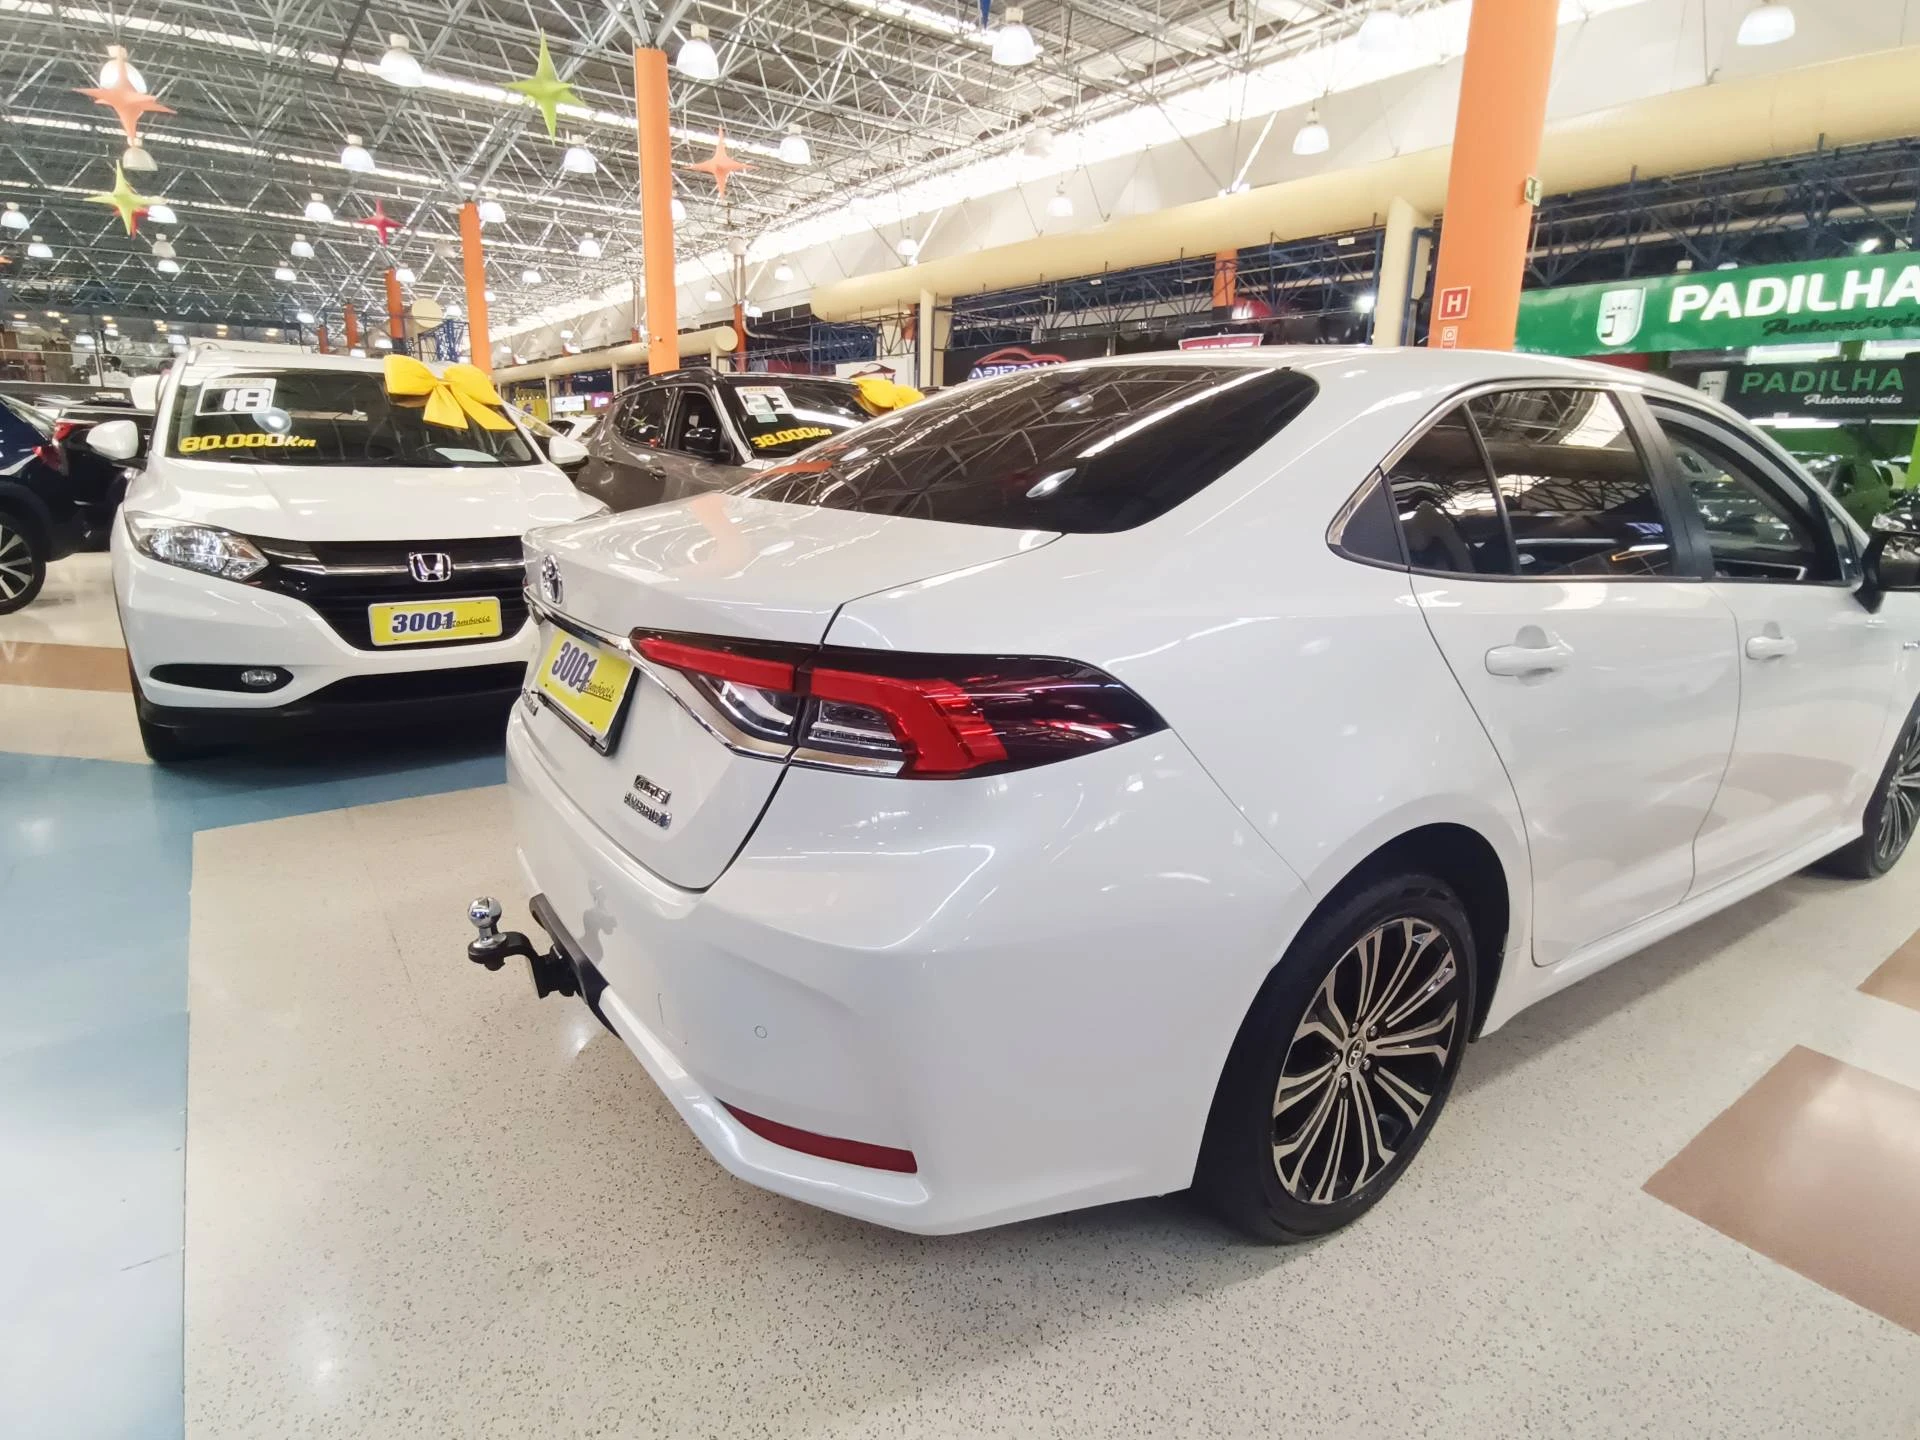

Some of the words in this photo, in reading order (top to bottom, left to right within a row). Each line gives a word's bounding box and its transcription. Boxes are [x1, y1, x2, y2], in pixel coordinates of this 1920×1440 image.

[447, 293, 462, 313] H
[1668, 265, 1920, 323] PADILHA
[1740, 367, 1904, 394] PADILHA
[222, 388, 272, 412] 18
[1803, 393, 1904, 406] Automóveis
[391, 611, 454, 634] 3001
[551, 641, 598, 694] 3001
